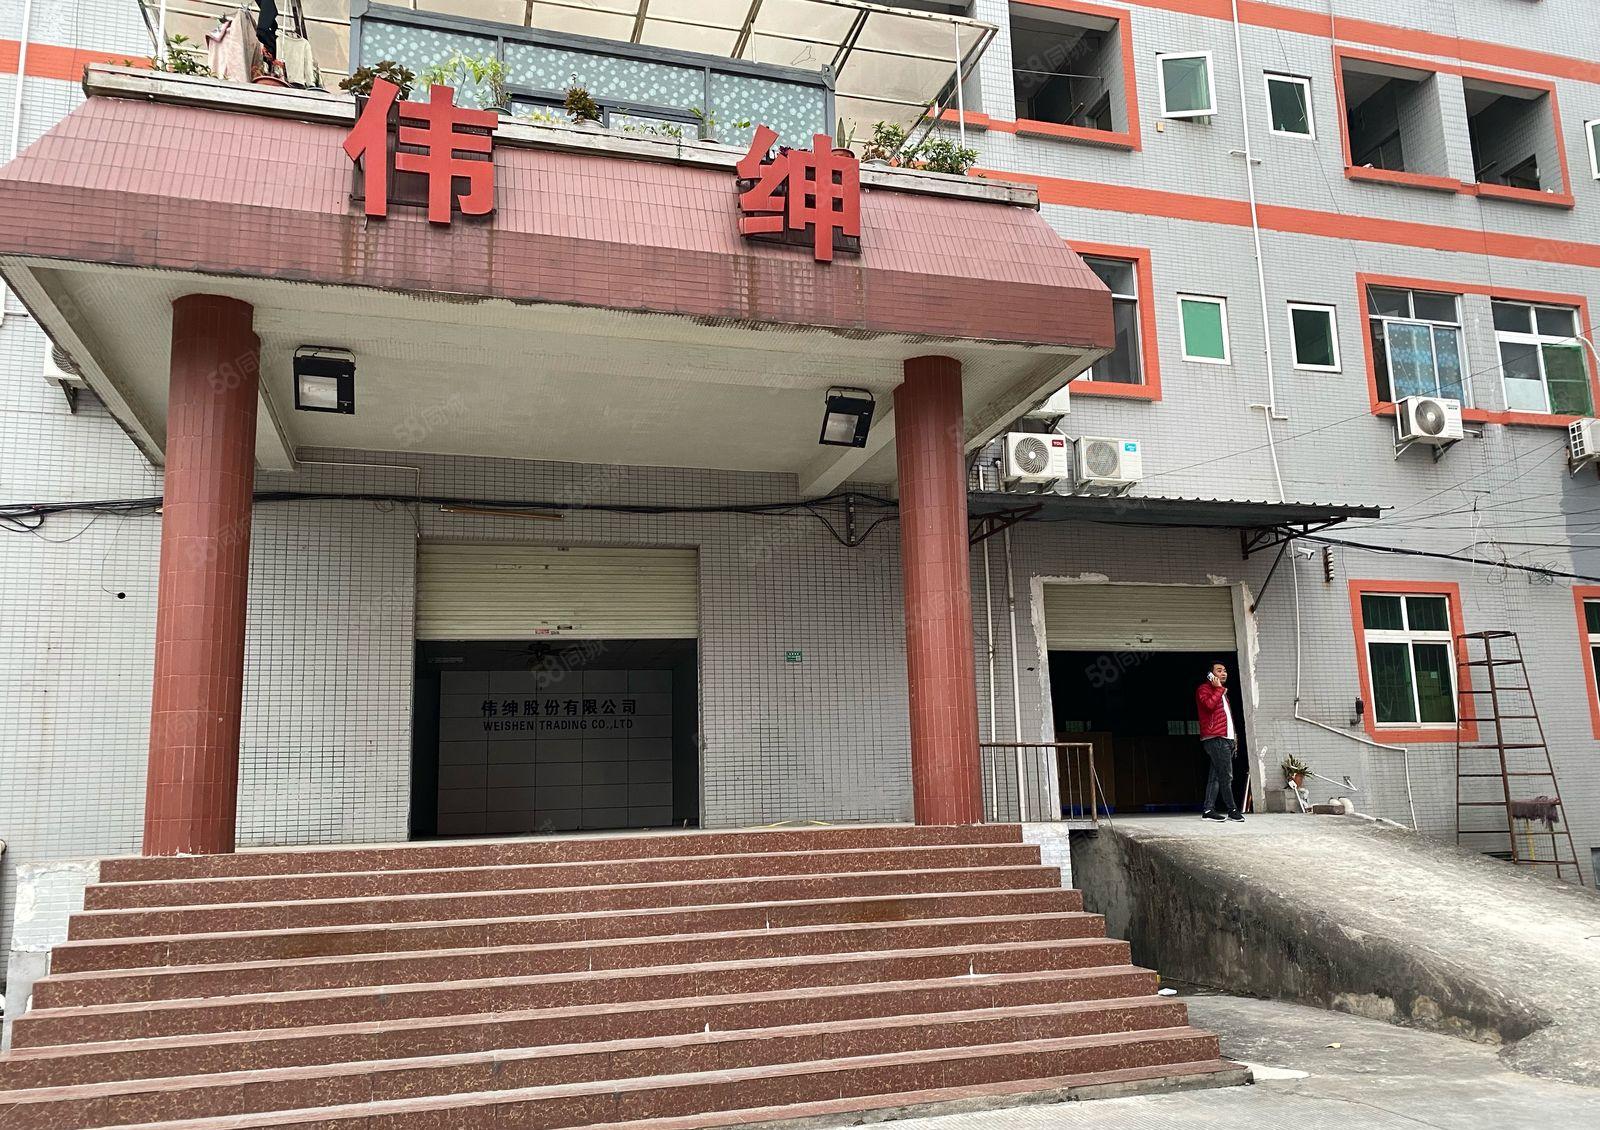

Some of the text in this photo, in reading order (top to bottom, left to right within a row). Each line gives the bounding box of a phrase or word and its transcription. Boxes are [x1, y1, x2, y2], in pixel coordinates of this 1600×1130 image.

[342, 76, 860, 261] 伟 绅
[481, 699, 637, 717] 伟绅股份有限公司
[483, 720, 534, 731] WEISHEN
[539, 719, 587, 730] TRADING
